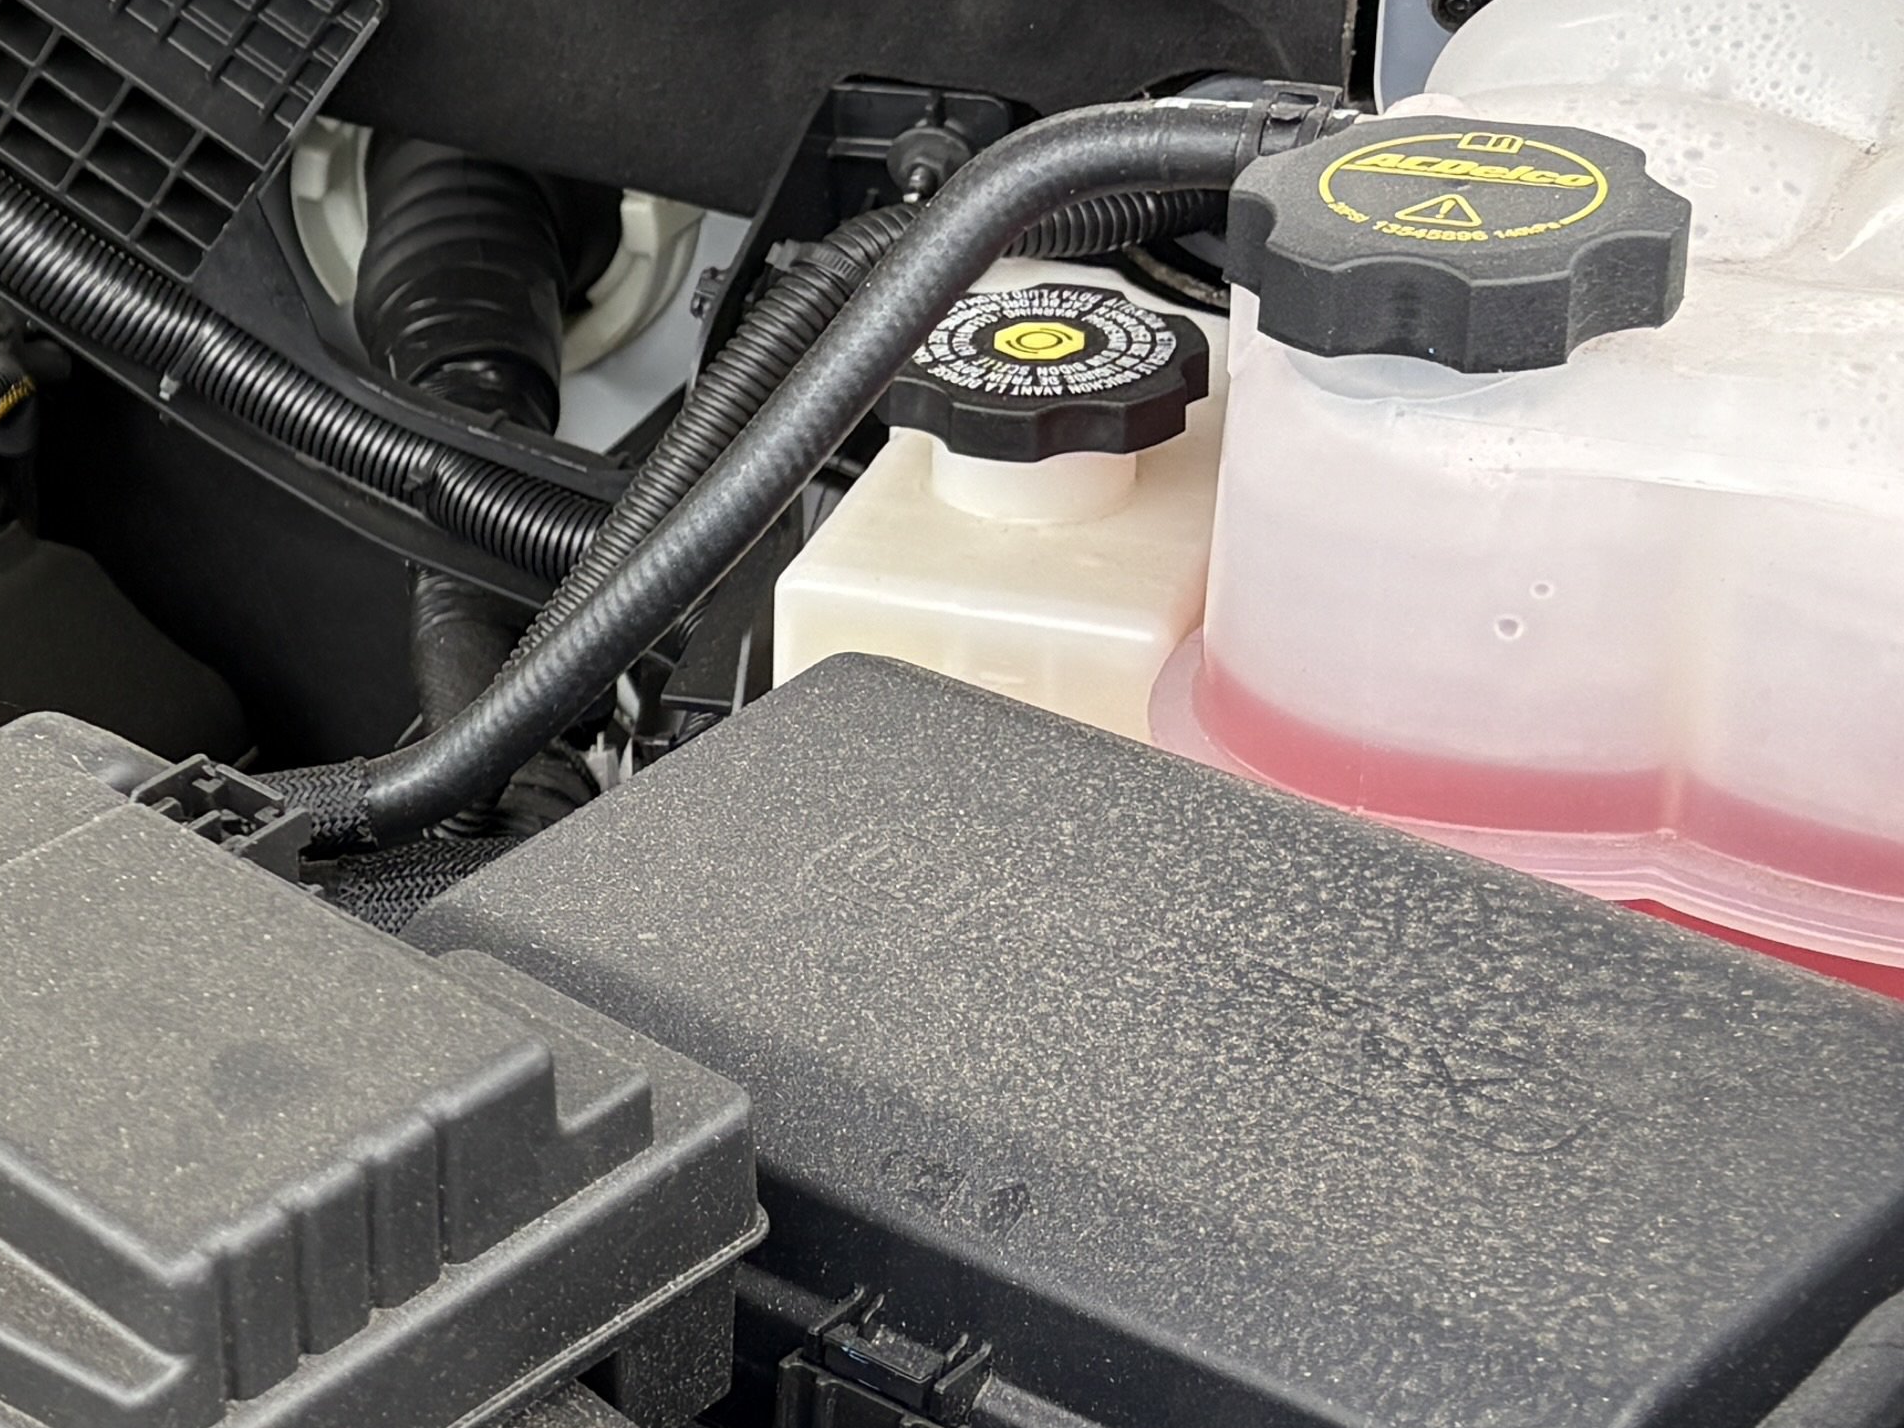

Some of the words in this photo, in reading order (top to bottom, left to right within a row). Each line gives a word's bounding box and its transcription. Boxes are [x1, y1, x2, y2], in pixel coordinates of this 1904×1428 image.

[1354, 153, 1595, 187] ACDelco
[1036, 362, 1088, 375] BIDON
[984, 383, 1008, 394] LA
[1009, 386, 1063, 396] AVANT
